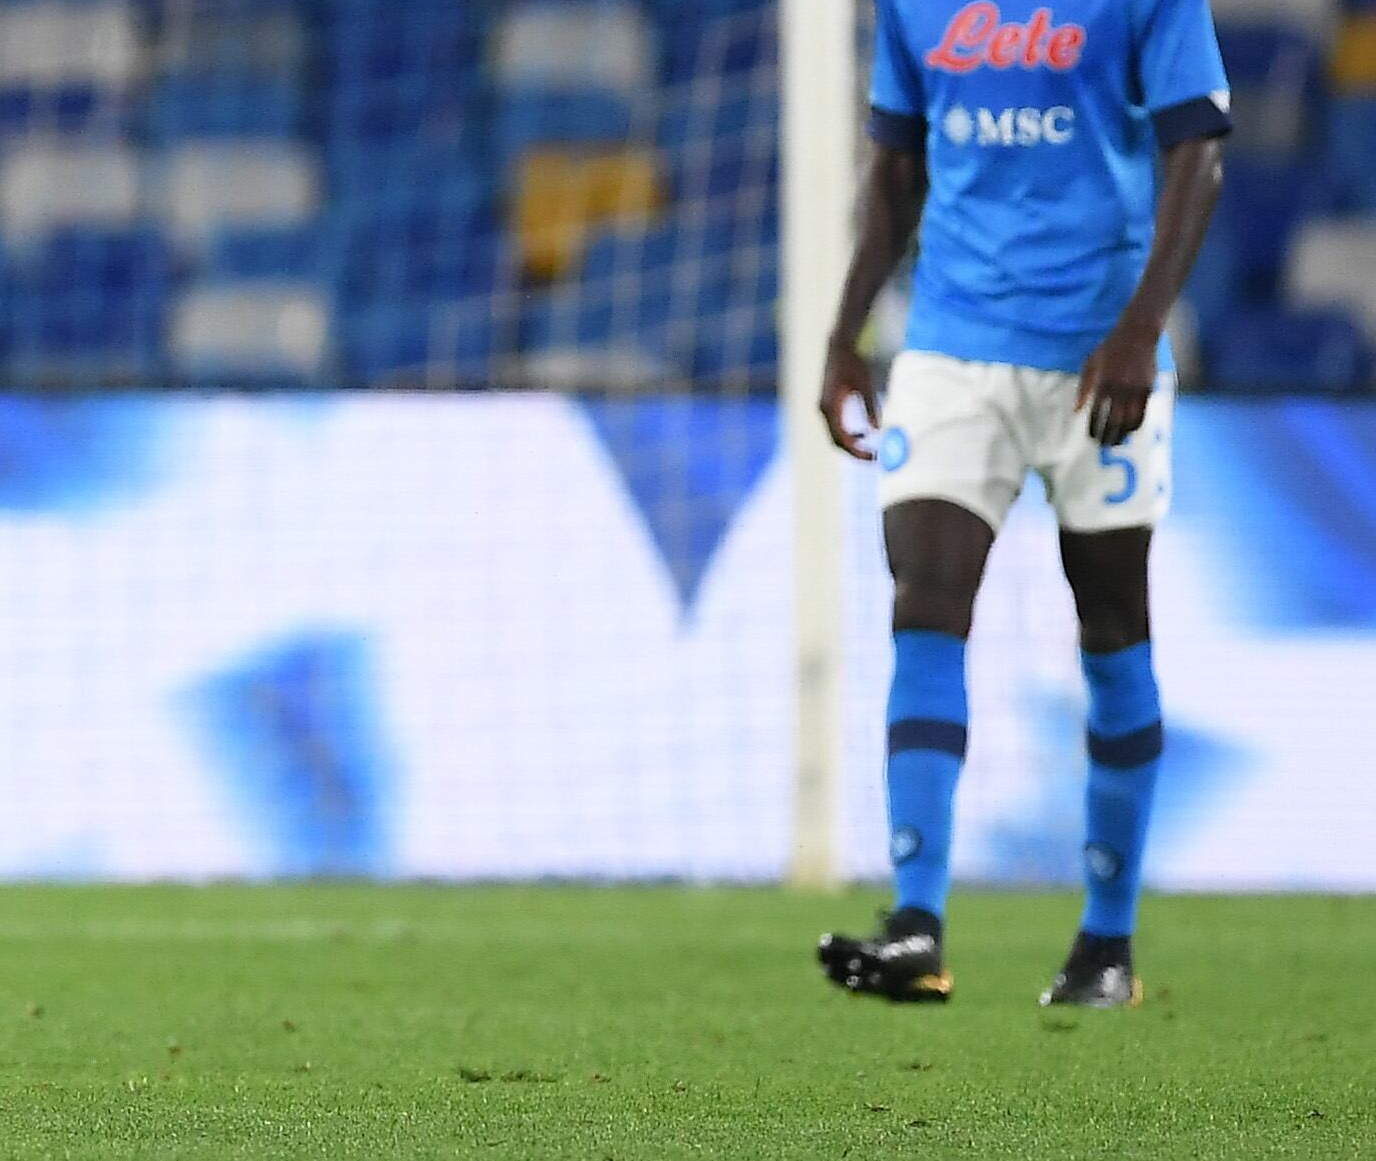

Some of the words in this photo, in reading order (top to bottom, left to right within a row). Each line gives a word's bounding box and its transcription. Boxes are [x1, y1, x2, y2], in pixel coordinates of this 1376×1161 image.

[924, 0, 1086, 74] Lete
[975, 104, 1077, 147] MSC
[1100, 436, 1138, 505] 5
